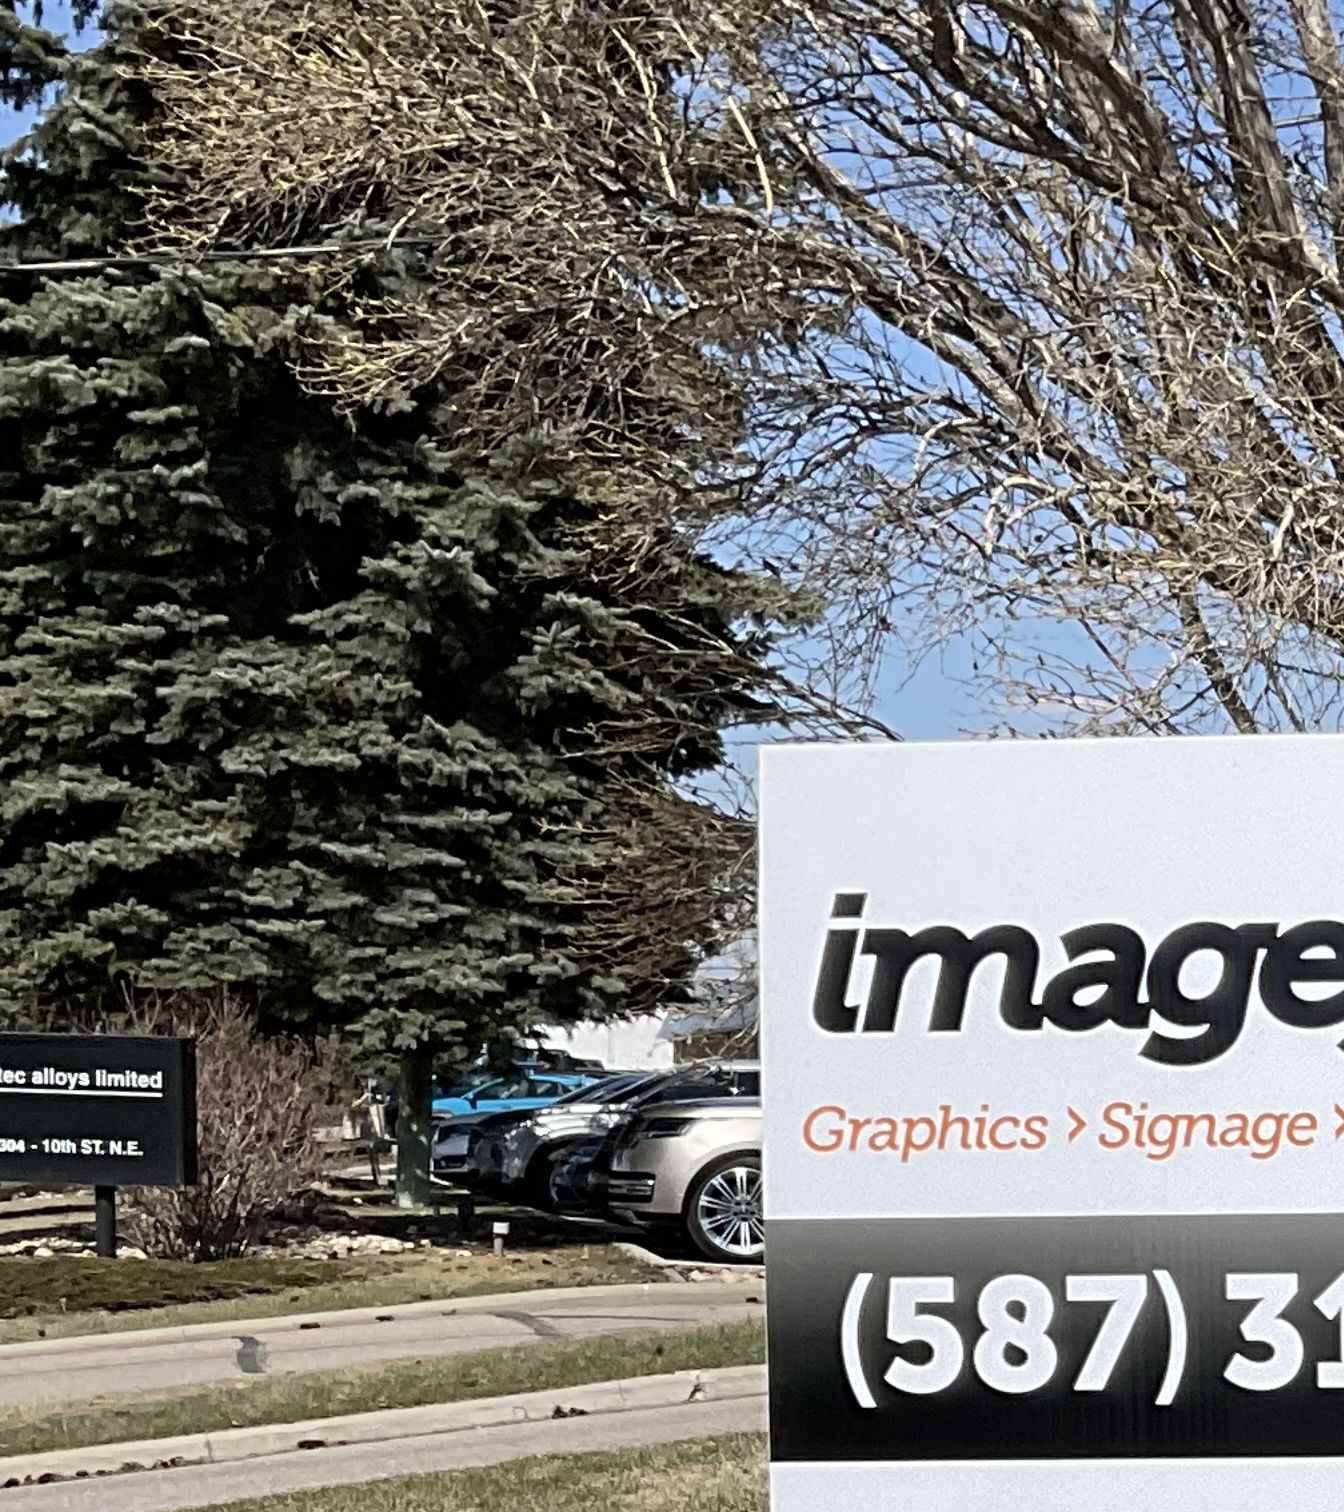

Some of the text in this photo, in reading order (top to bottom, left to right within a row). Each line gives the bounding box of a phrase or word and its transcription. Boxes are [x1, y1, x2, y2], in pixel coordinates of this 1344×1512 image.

[31, 1067, 91, 1091] alloys
[95, 1069, 163, 1089] limited
[42, 1138, 77, 1154] 10th
[80, 1138, 106, 1155] ST.
[109, 1140, 144, 1156] N.E.
[803, 1105, 1047, 1162] Graphics
[1099, 1102, 1318, 1161] Signage
[841, 1268, 1188, 1409] (587)
